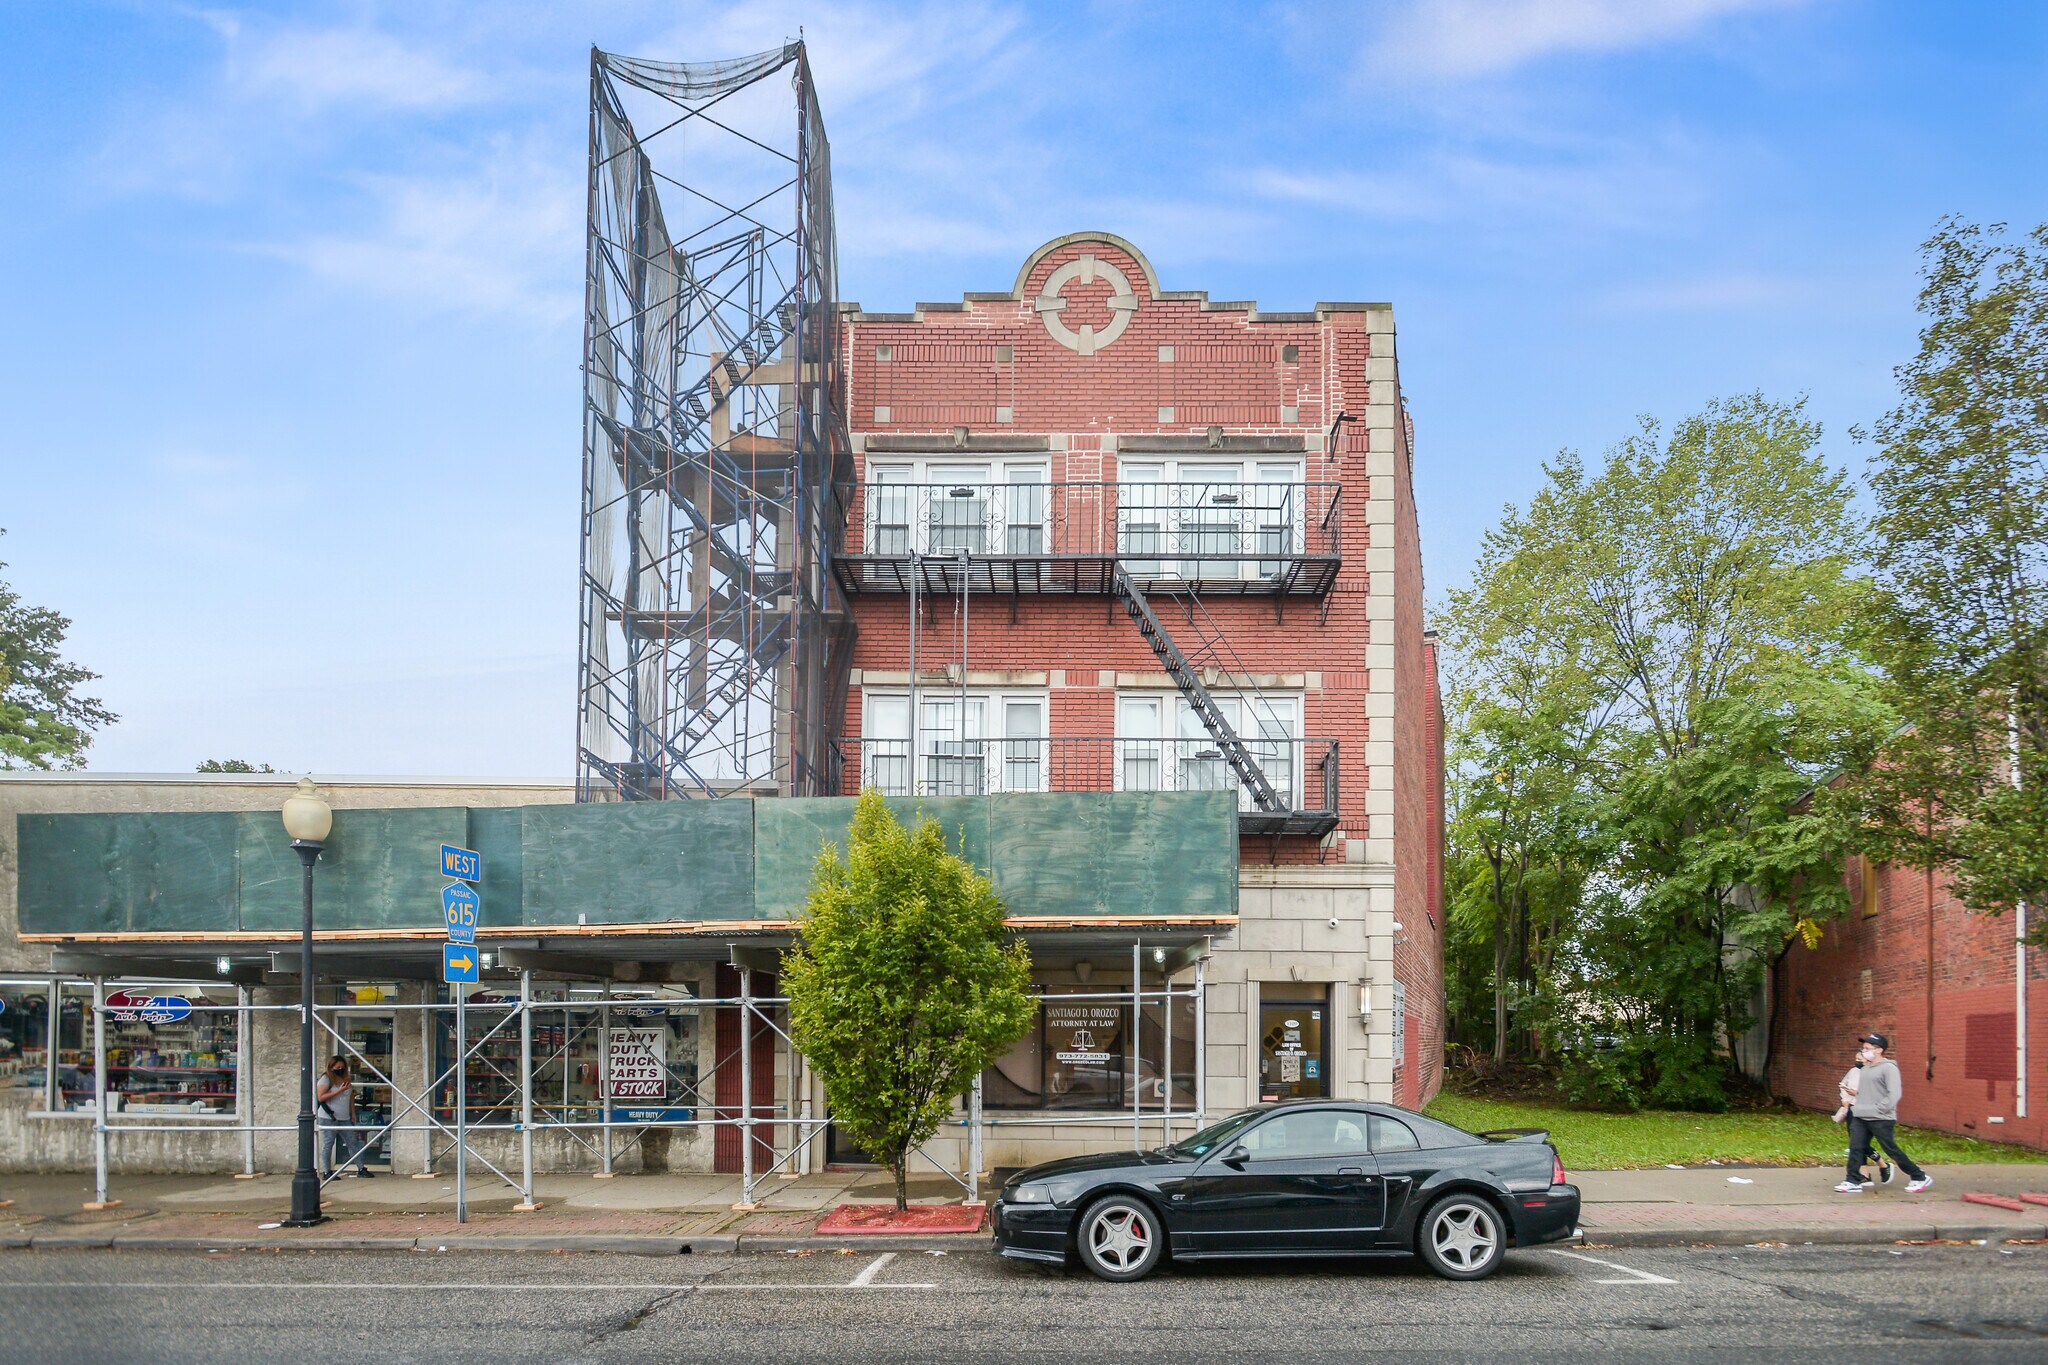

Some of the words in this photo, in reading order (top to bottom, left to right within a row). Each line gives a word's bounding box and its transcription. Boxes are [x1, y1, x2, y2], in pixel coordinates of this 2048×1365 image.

[445, 852, 476, 874] WEST
[450, 889, 471, 899] PASSAIC
[448, 901, 474, 926] 615
[450, 929, 471, 938] COUNTY
[1047, 1008, 1081, 1018] SANTIAGO
[1082, 1008, 1089, 1018] D.
[1091, 1008, 1120, 1018] OROZCO
[610, 1034, 658, 1043] HEAVY
[611, 1045, 652, 1054] DUTY
[610, 1069, 658, 1078] PARTS
[610, 1082, 618, 1094] N
[619, 1081, 662, 1095] STOCK
[645, 1111, 659, 1119] DUTY
